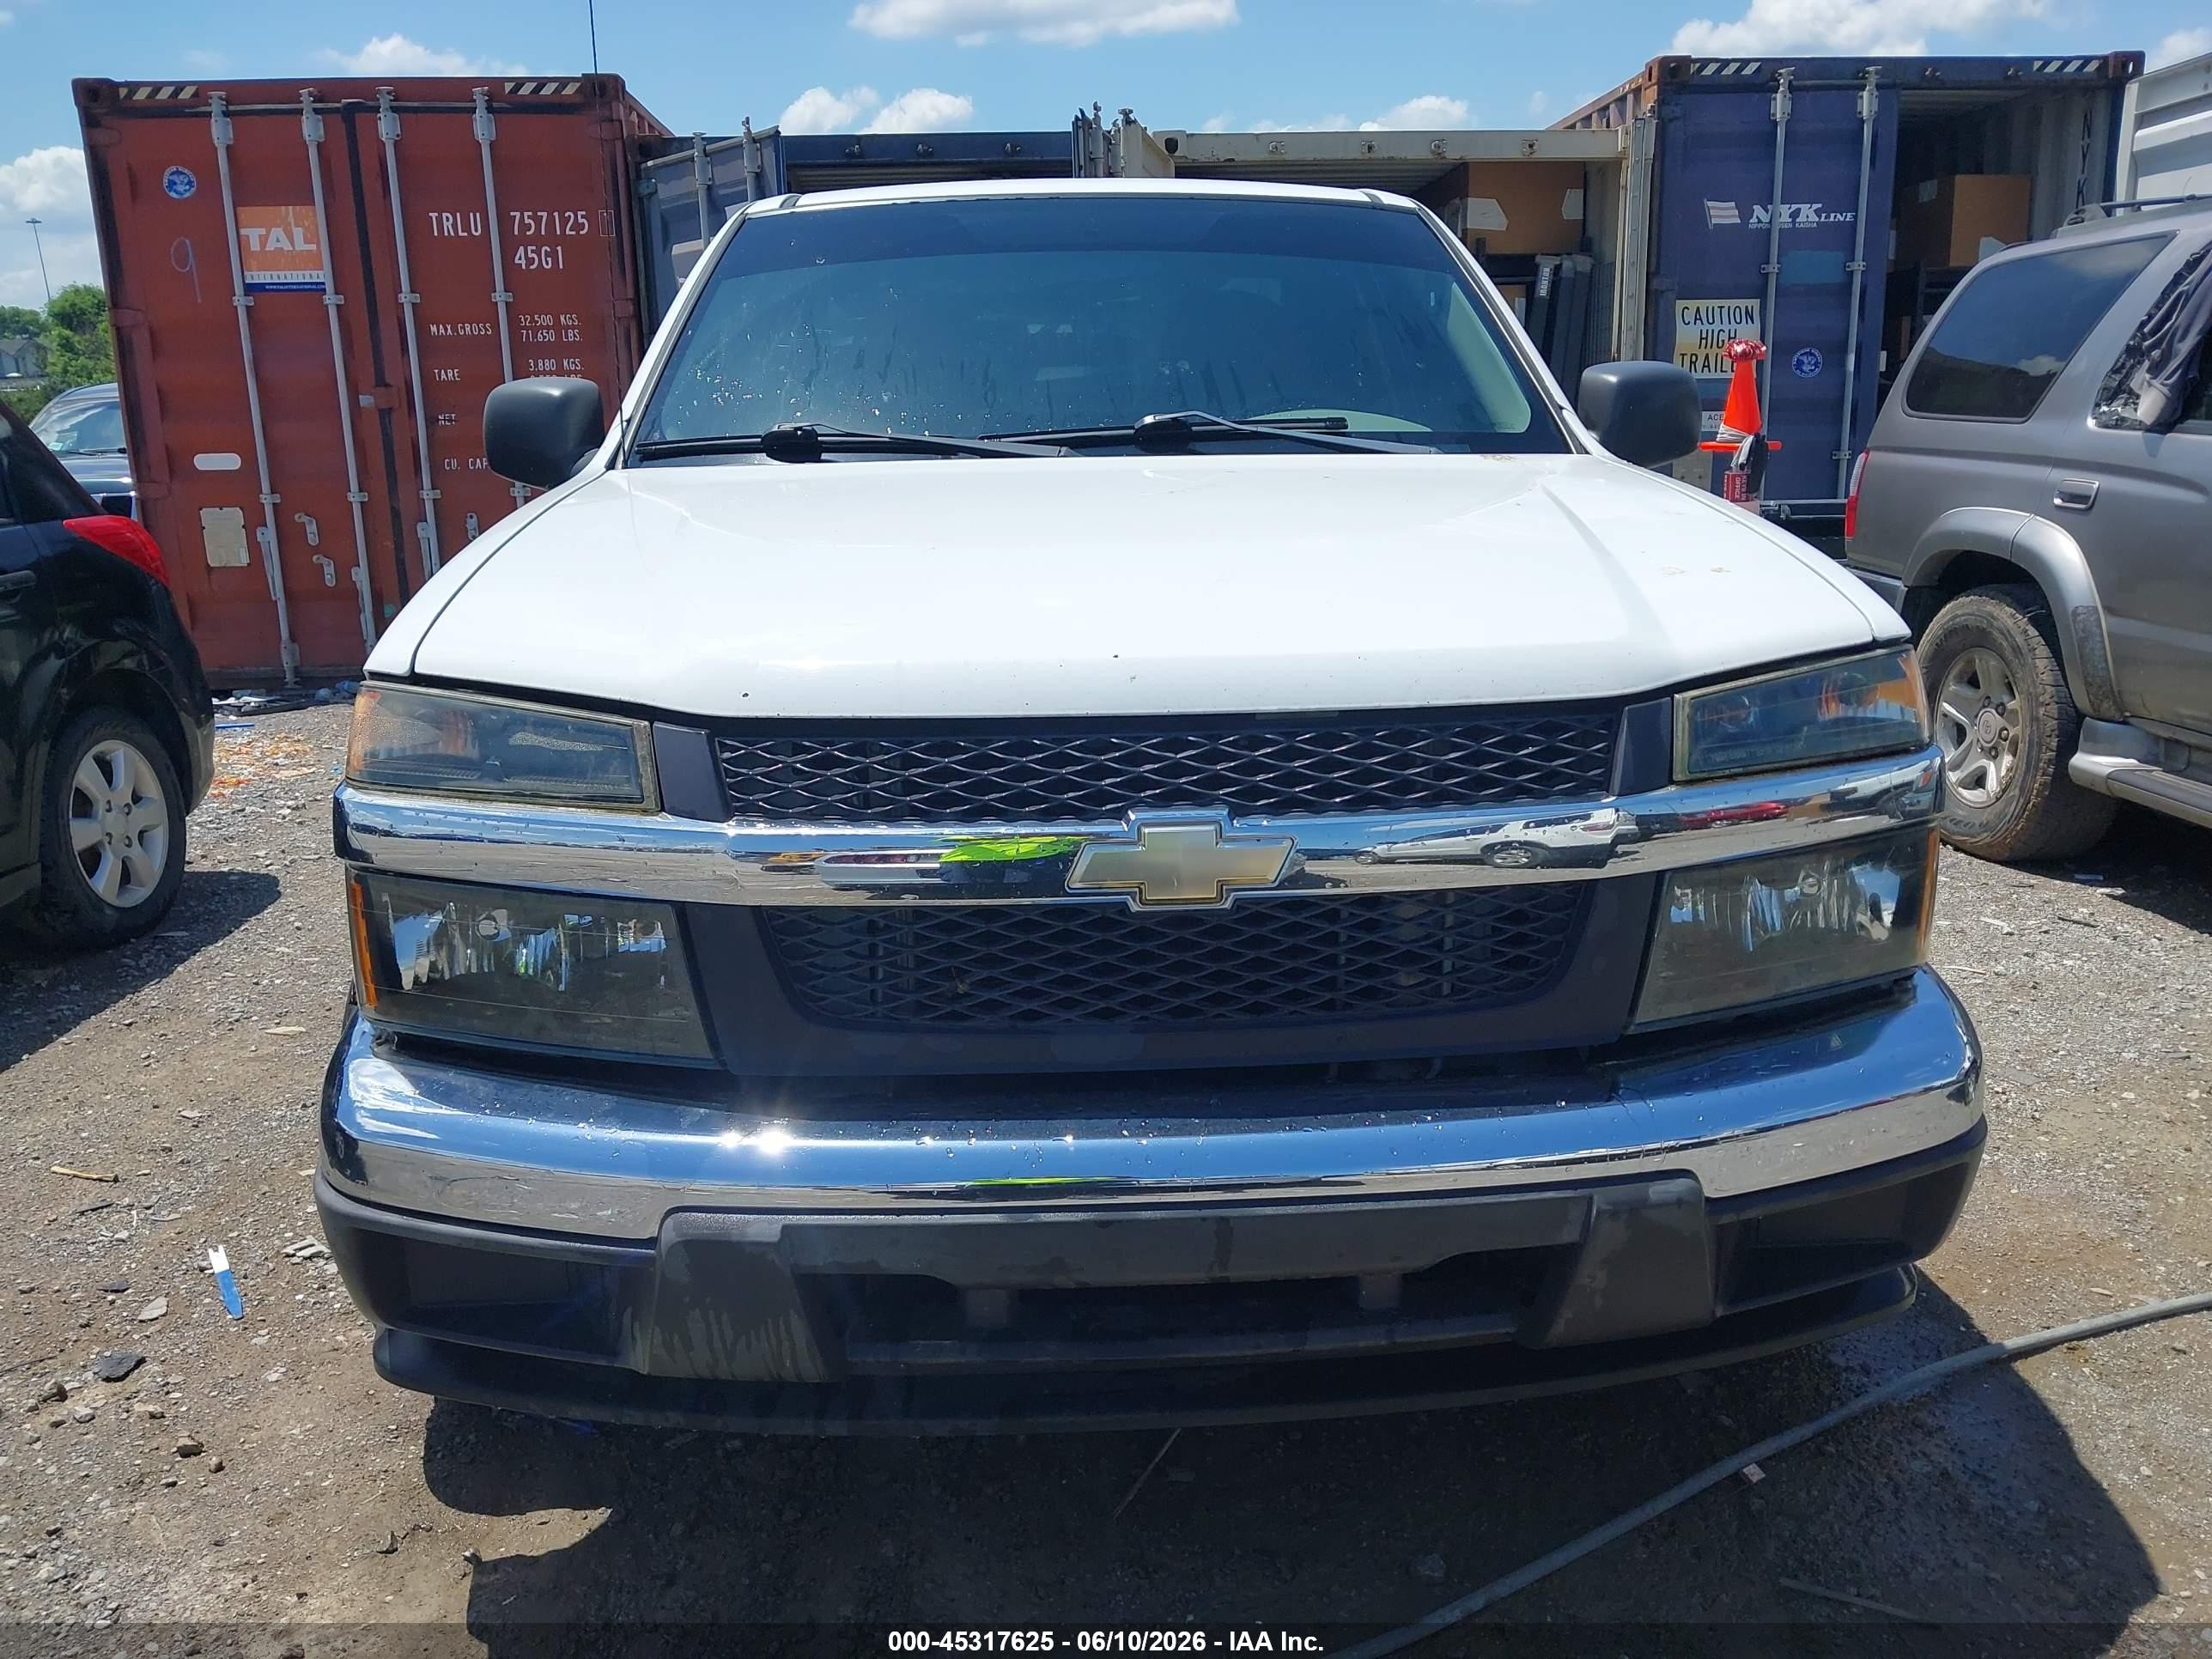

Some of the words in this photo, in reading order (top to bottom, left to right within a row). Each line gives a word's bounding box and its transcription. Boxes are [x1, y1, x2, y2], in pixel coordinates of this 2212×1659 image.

[1749, 204, 1822, 222] NYK
[1820, 212, 1856, 222] LINE
[429, 212, 482, 236] TRLU
[510, 211, 589, 235] 757125
[240, 227, 316, 251] TAL
[514, 246, 564, 270] 45G1
[518, 314, 554, 326] 32.500
[560, 313, 582, 325] KGS.
[1680, 305, 1755, 325] CAUTION
[520, 330, 556, 342] 71.650
[562, 329, 583, 342] LBS.
[1698, 328, 1737, 349] HIGH
[562, 358, 585, 371] KGS.
[433, 369, 461, 381] TARE
[444, 459, 460, 470] CU.
